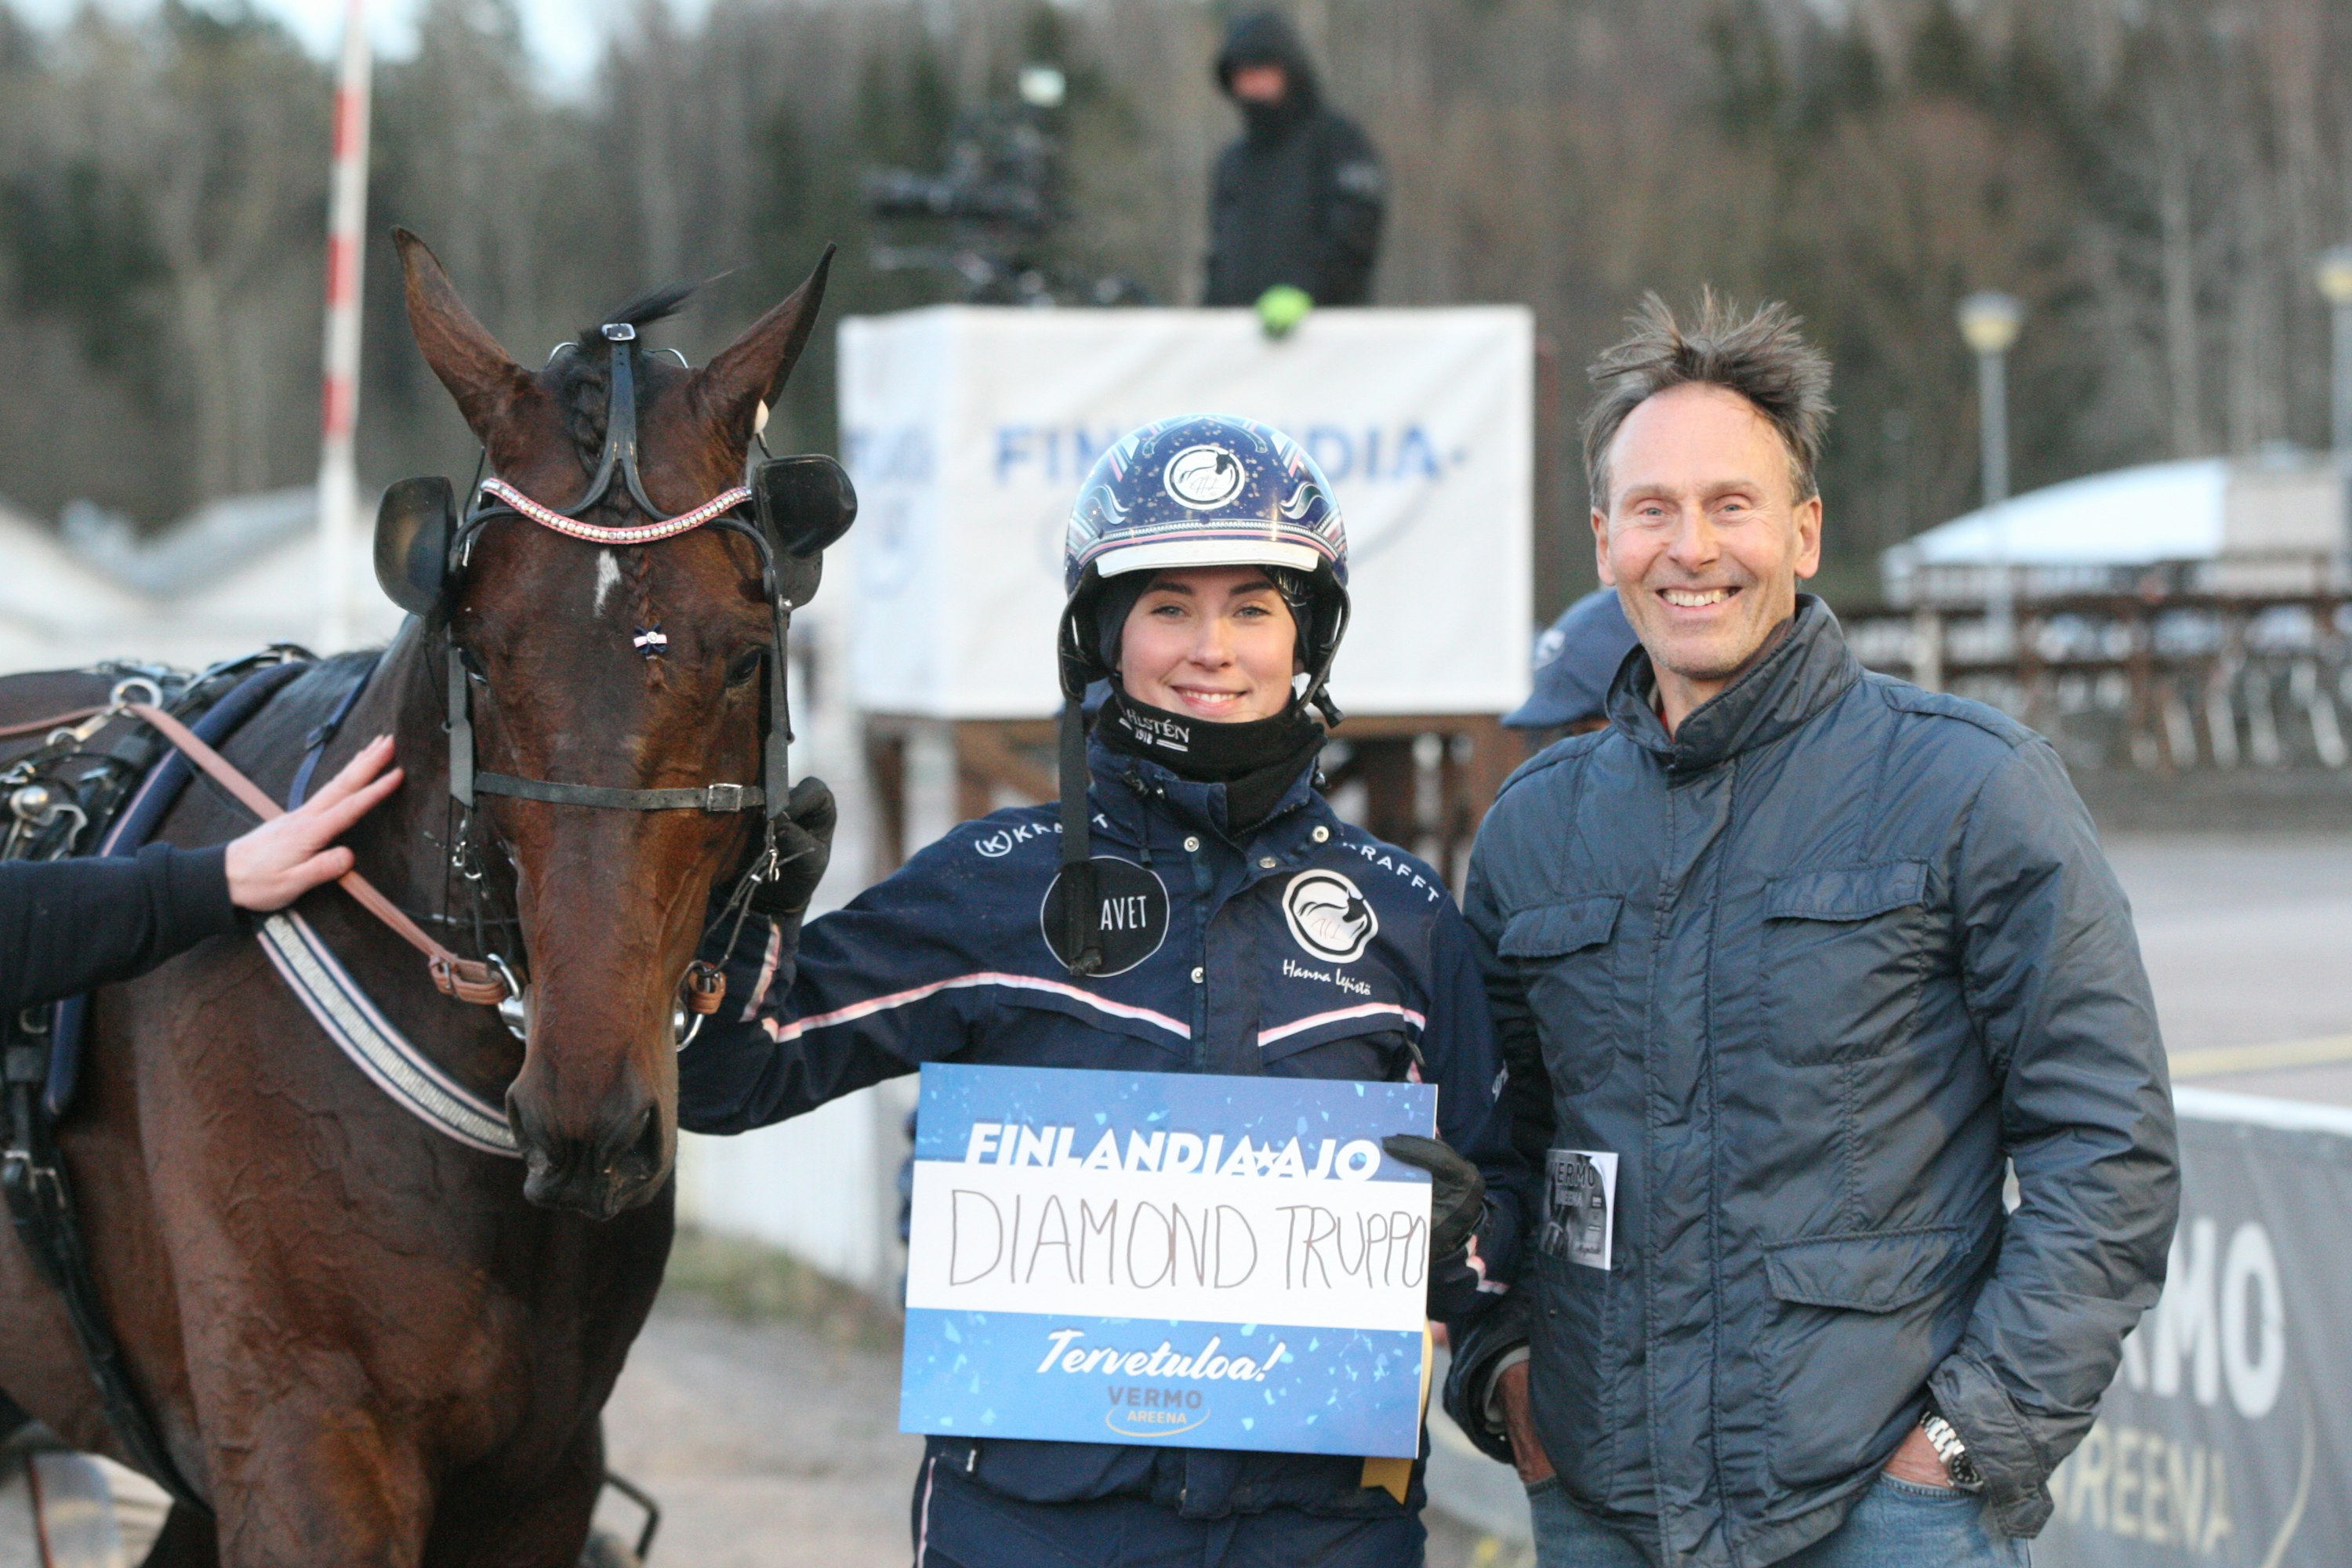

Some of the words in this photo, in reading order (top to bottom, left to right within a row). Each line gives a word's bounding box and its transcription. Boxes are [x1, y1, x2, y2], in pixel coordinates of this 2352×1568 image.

[1135, 728, 1153, 745] 1918
[1283, 959, 1331, 982] Hanna
[949, 1189, 1258, 1289] DIAMOND
[1275, 1204, 1428, 1290] TRUPPO
[1036, 1329, 1286, 1382] Tervetuloa!
[1107, 1385, 1203, 1410] VERMO
[1127, 1410, 1188, 1425] AREENA
